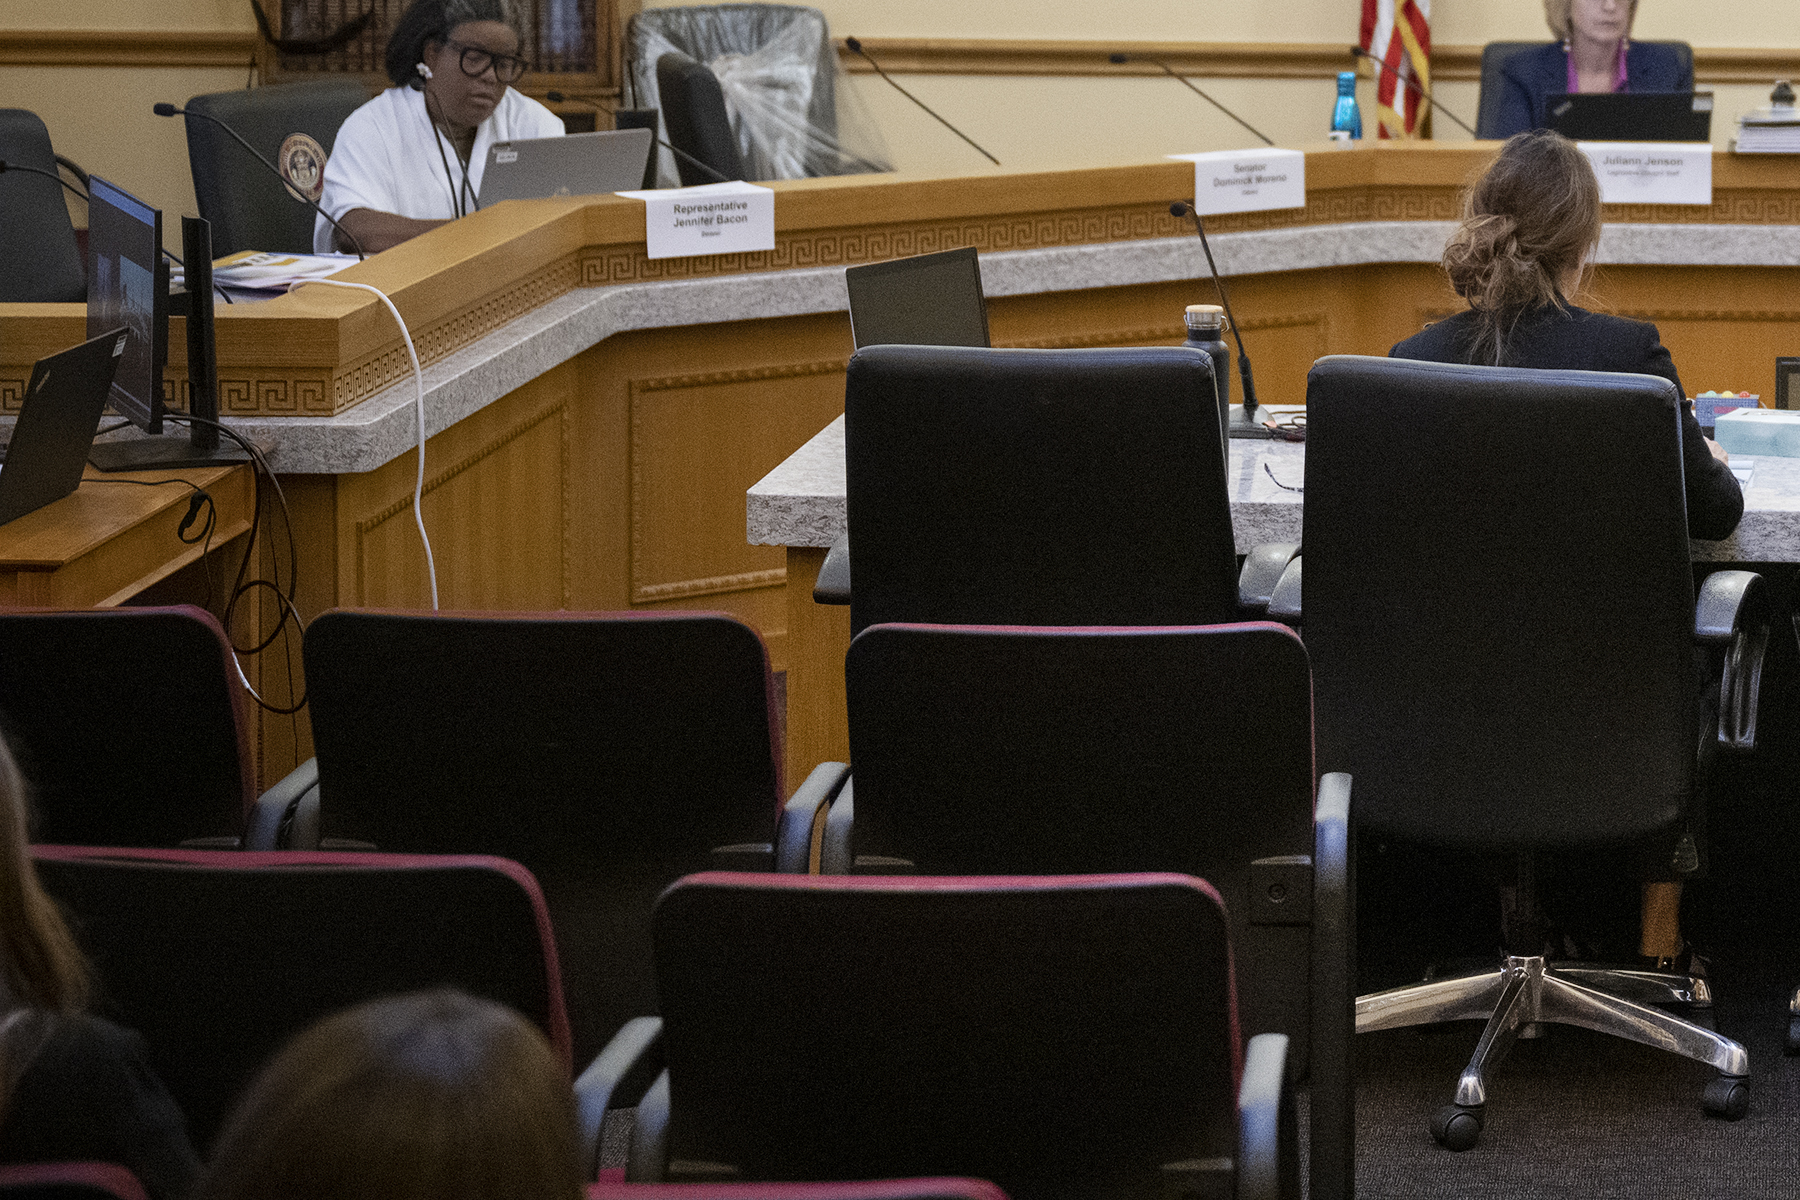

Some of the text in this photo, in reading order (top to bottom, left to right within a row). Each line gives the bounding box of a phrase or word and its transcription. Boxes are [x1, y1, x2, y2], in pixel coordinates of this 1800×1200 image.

[1233, 164, 1267, 173] Senator
[673, 201, 748, 215] Representative
[673, 214, 748, 228] Jennifer Bacon
